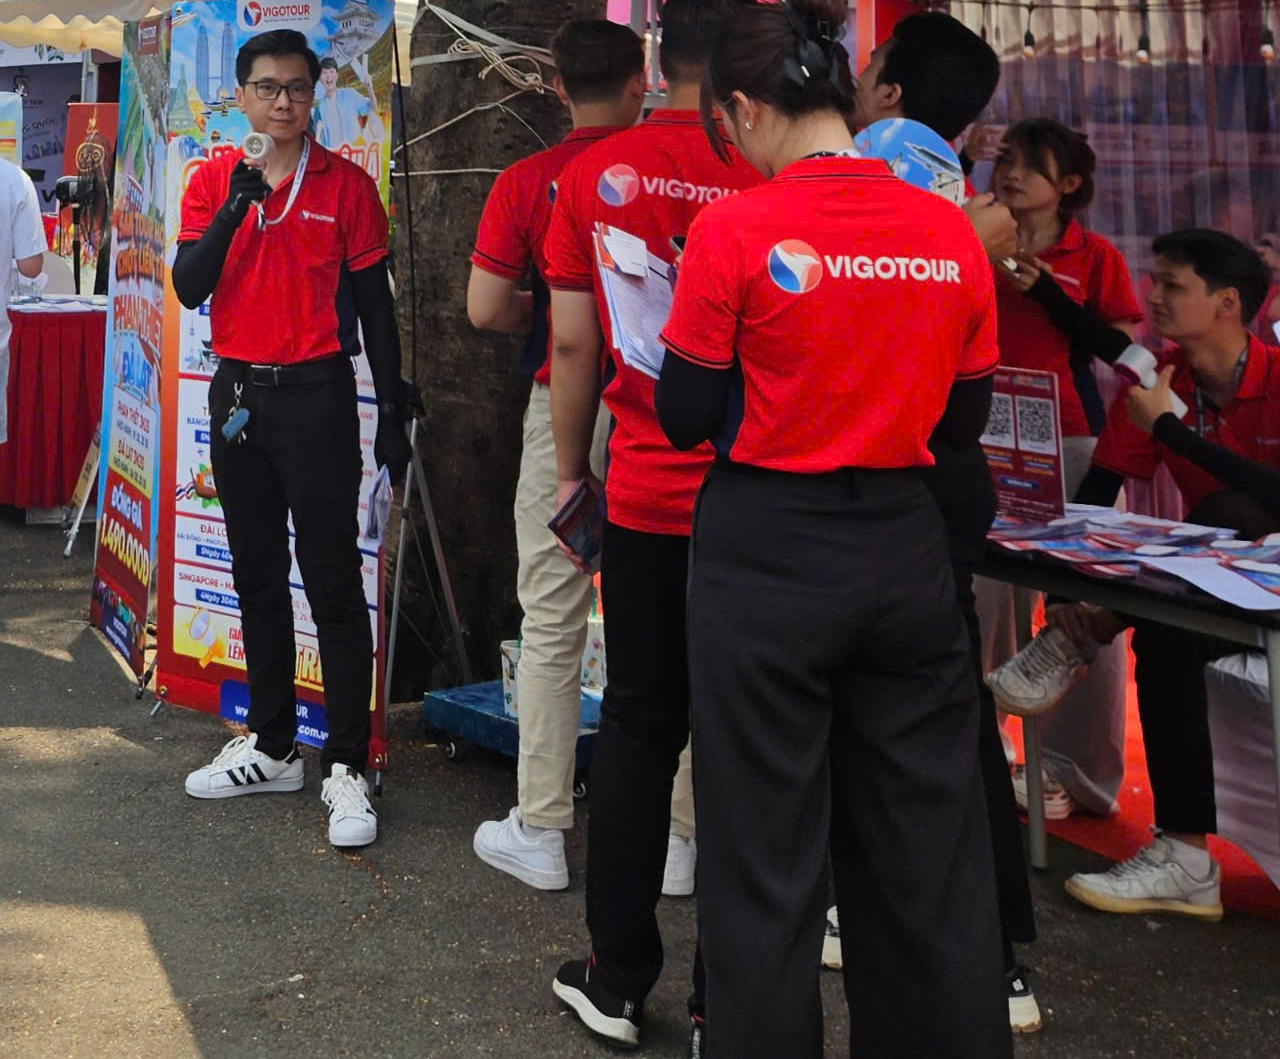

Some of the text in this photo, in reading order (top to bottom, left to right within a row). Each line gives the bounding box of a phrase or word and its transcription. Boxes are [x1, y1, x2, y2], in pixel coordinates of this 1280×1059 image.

[262, 4, 311, 17] VIGOTOUR
[642, 175, 739, 204] VIGOTO
[824, 255, 961, 284] VIGOTOUR
[178, 572, 218, 588] SINGAPORE
